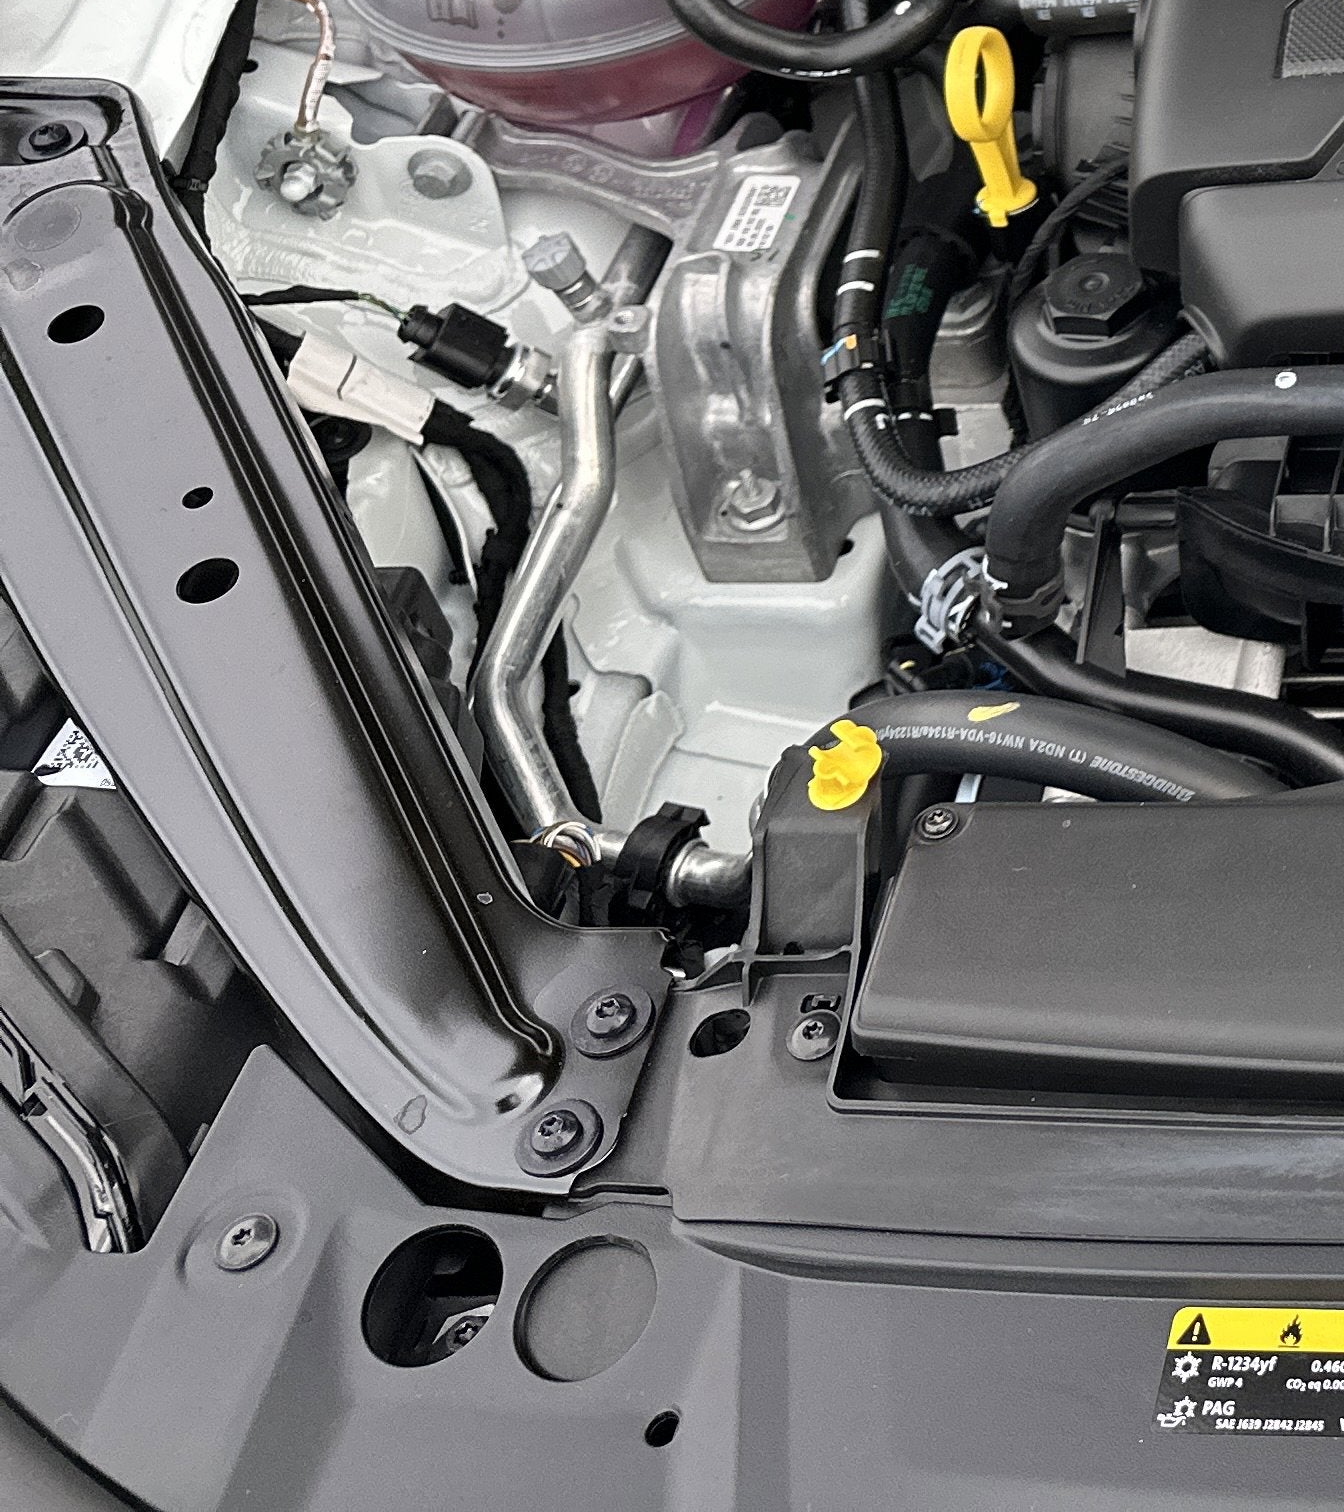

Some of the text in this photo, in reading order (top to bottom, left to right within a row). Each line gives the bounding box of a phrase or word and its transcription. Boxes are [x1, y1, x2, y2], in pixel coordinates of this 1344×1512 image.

[1028, 737, 1065, 757] ND2A
[1088, 755, 1195, 802] BRIDGESTONE
[1211, 1355, 1278, 1376] R-1234yf
[1207, 1377, 1234, 1388] GWP
[1234, 1377, 1244, 1388] 4
[1202, 1400, 1236, 1416] PAG
[1215, 1418, 1236, 1429] SAE
